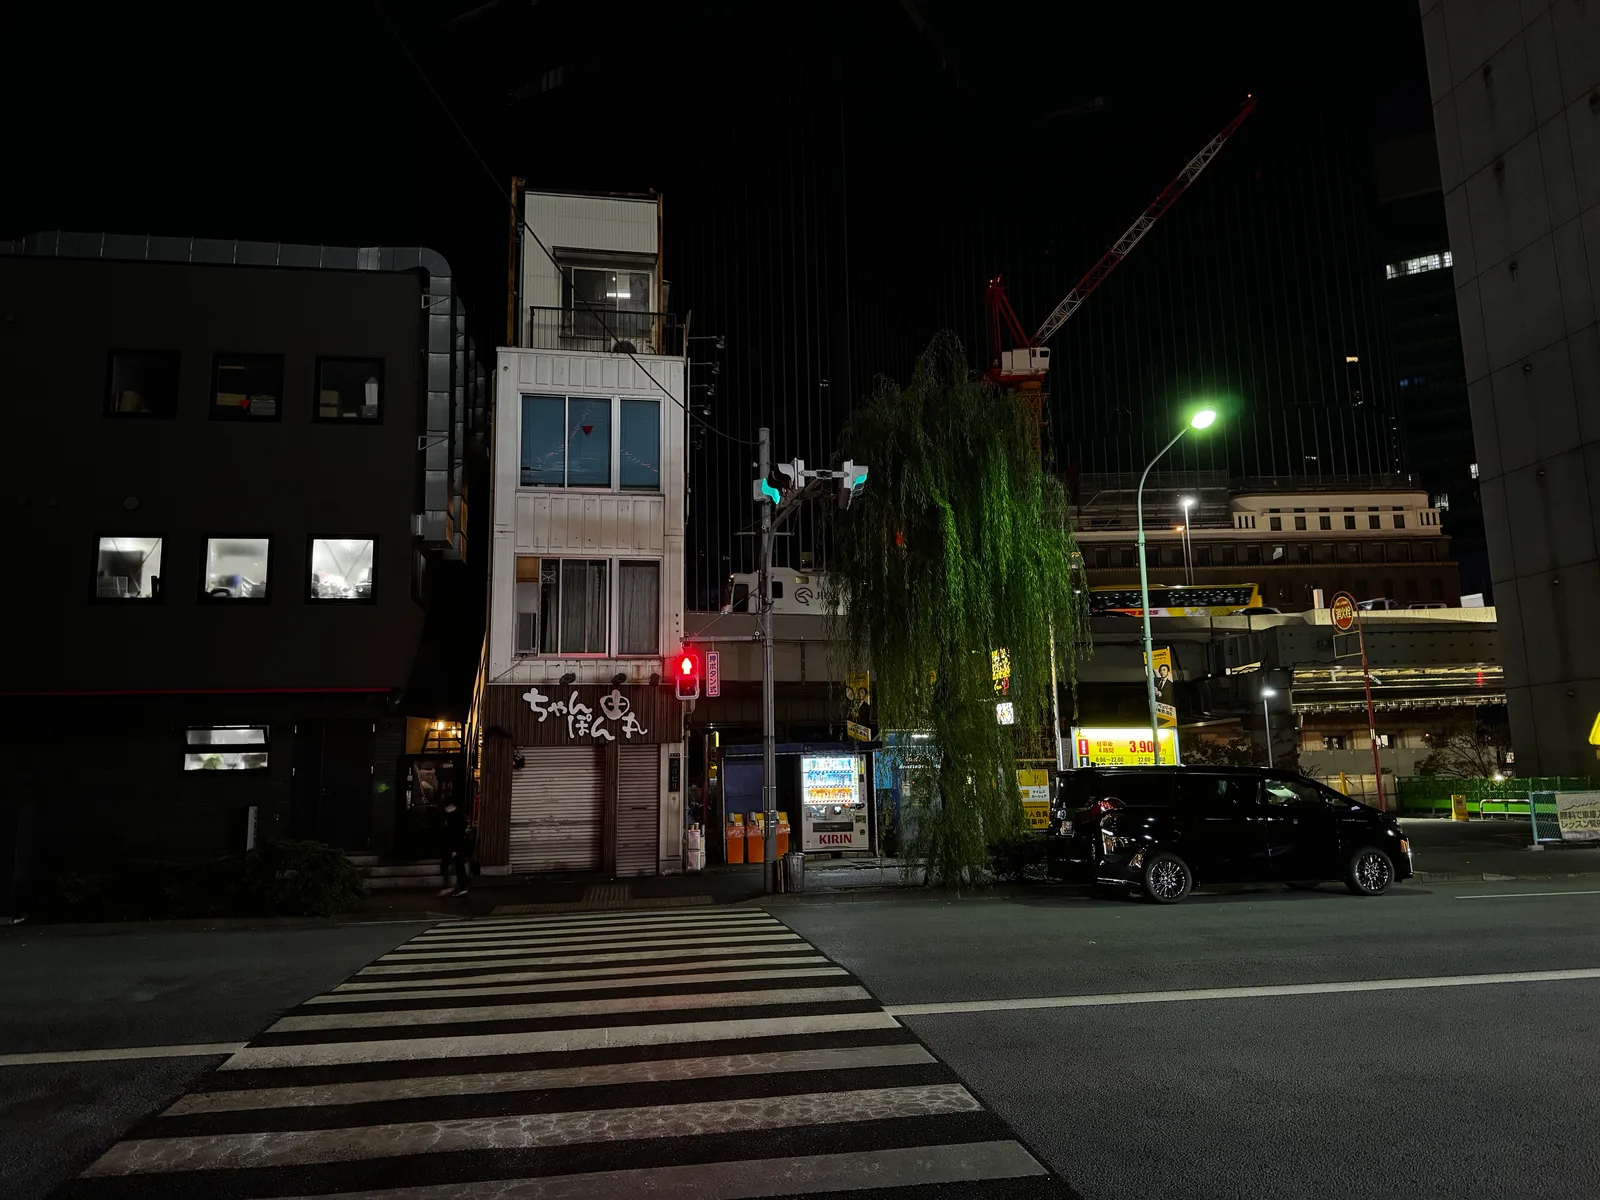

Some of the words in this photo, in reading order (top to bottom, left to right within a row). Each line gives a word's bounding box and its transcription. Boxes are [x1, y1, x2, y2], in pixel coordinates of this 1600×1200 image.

[708, 655, 717, 694] 押ボタン式
[818, 834, 852, 845] KIRIN
